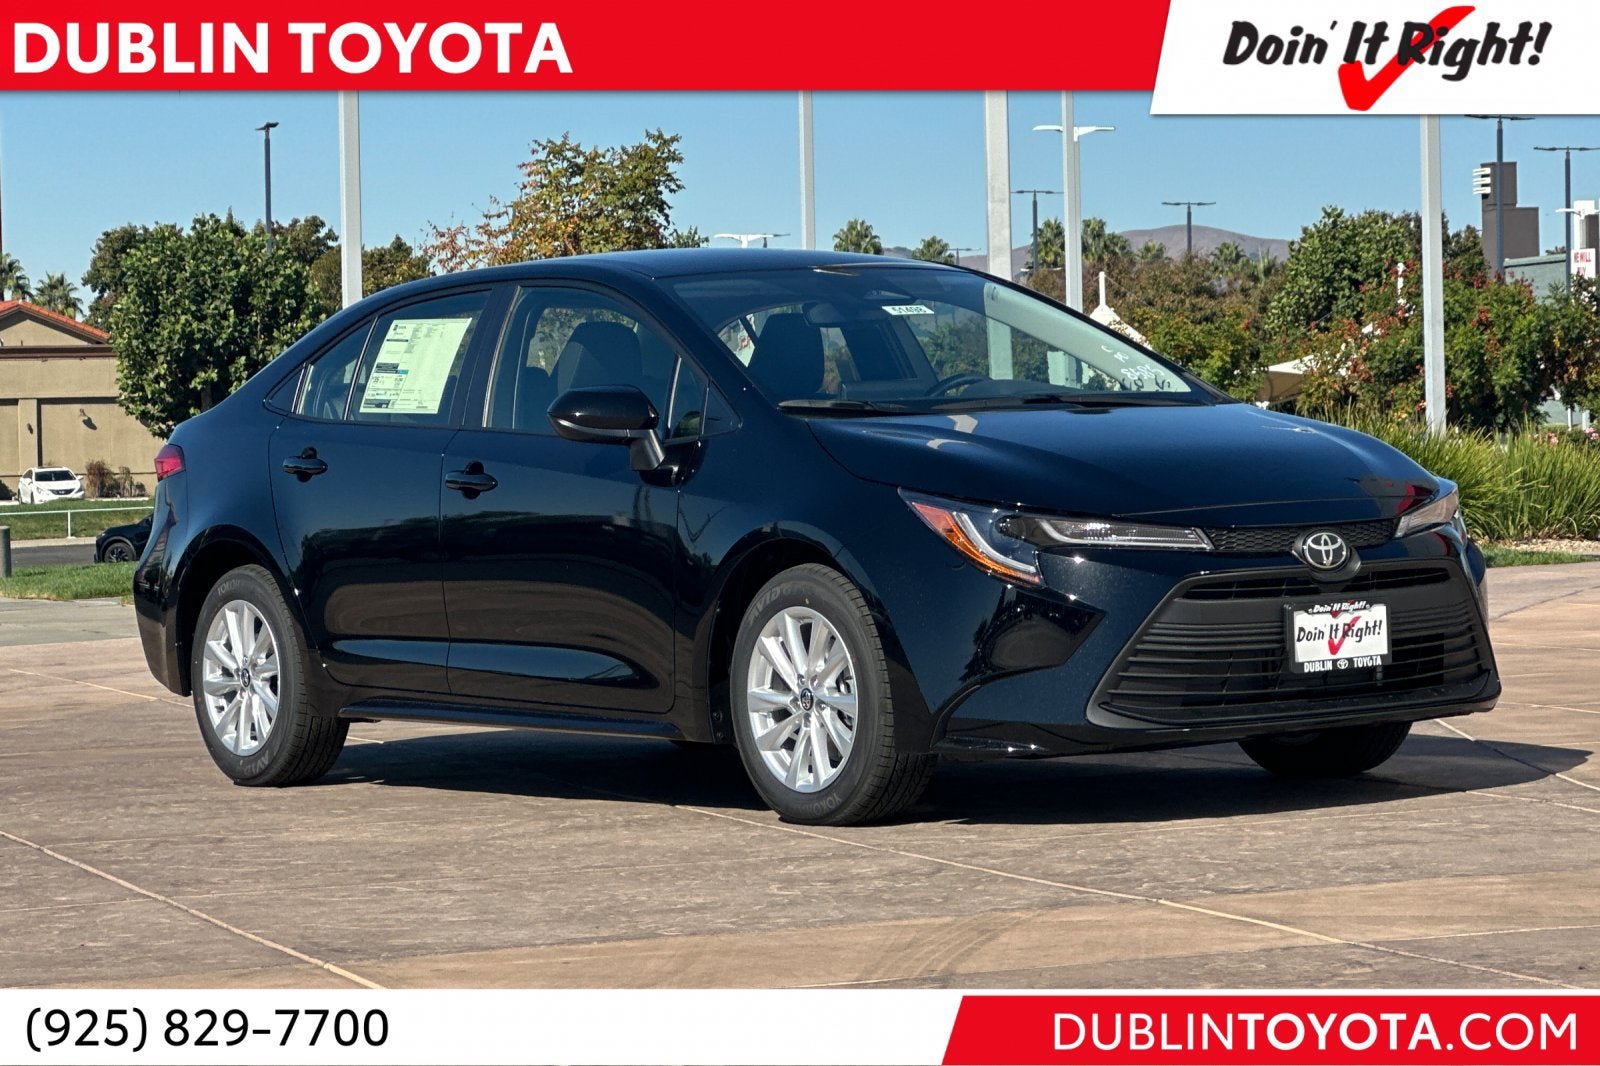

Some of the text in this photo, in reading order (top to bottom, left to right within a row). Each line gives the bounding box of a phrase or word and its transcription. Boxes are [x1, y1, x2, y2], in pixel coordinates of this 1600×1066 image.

[1333, 602, 1341, 612] It
[1341, 601, 1367, 614] Right!
[1296, 619, 1383, 643] Doin' It Right!
[1304, 655, 1382, 673] DUBLIN TOYOTA
